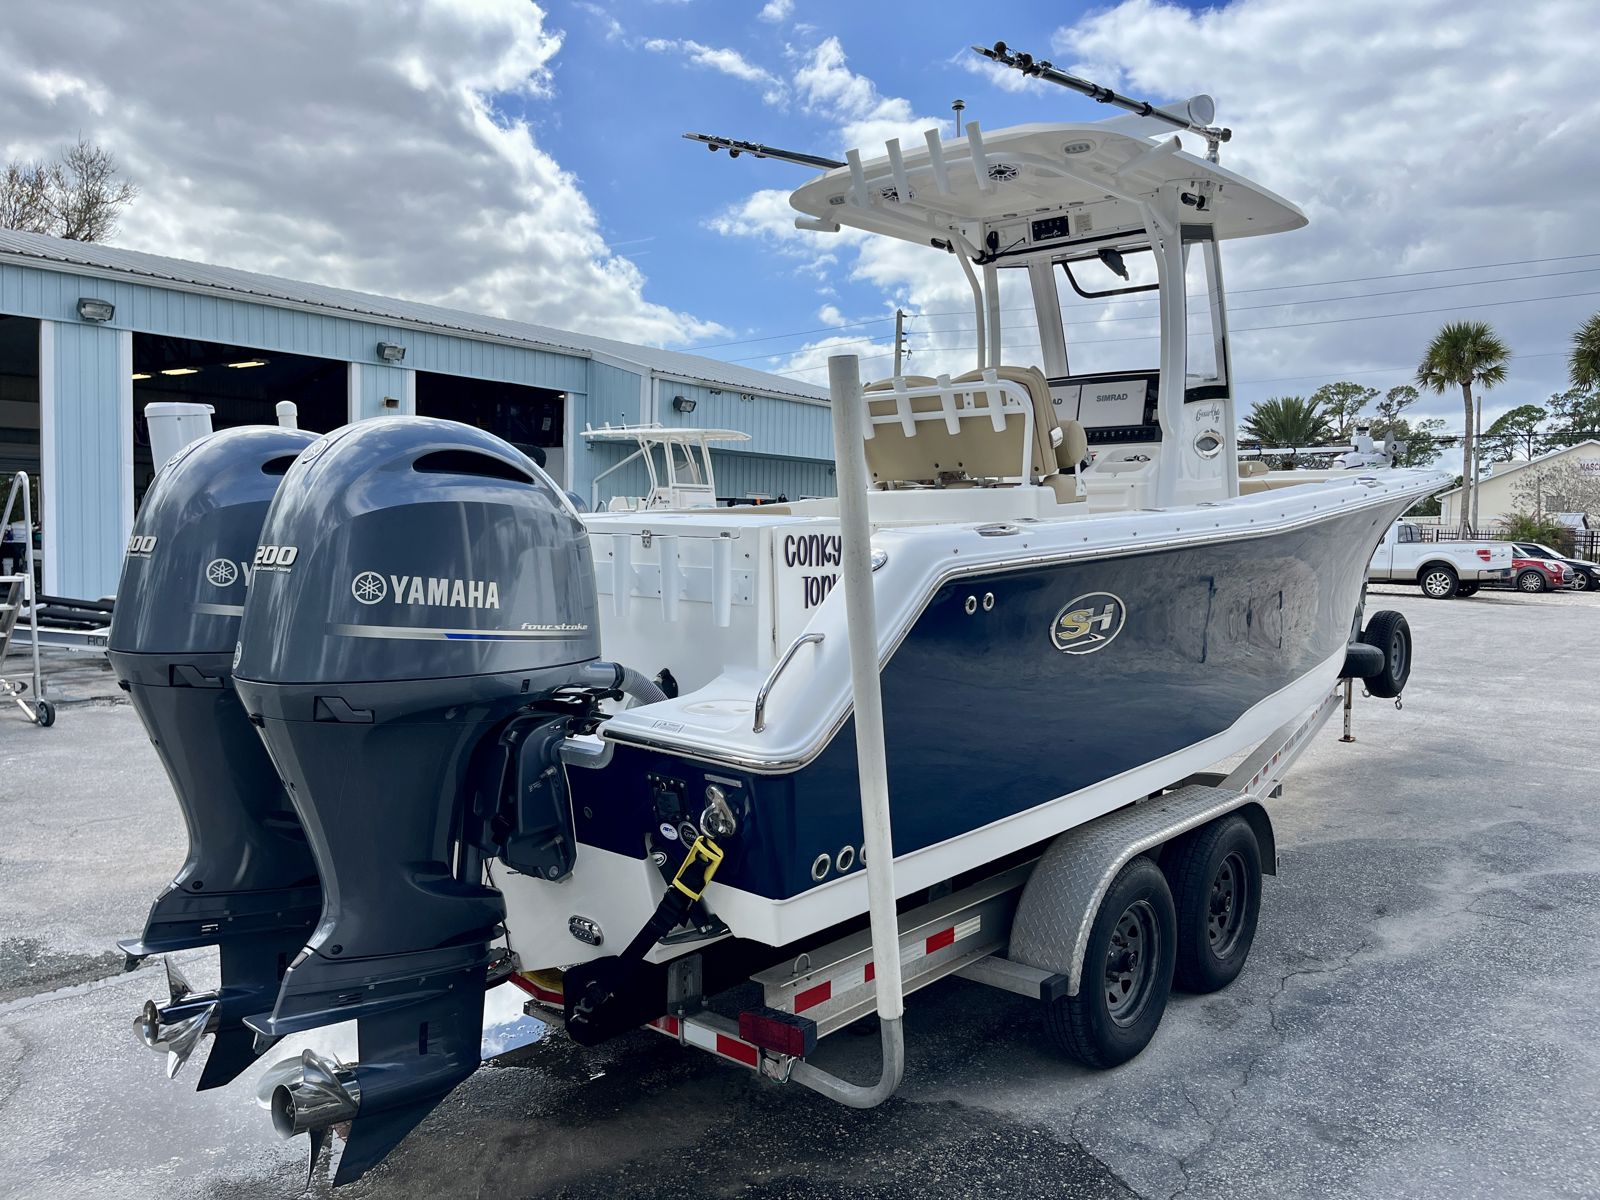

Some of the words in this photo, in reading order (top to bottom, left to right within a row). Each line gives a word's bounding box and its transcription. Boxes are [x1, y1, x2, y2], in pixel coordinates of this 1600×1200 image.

[1096, 393, 1128, 402] SIMRAD
[128, 535, 158, 552] 00
[253, 545, 298, 566] 200
[390, 574, 500, 609] YAMAHA
